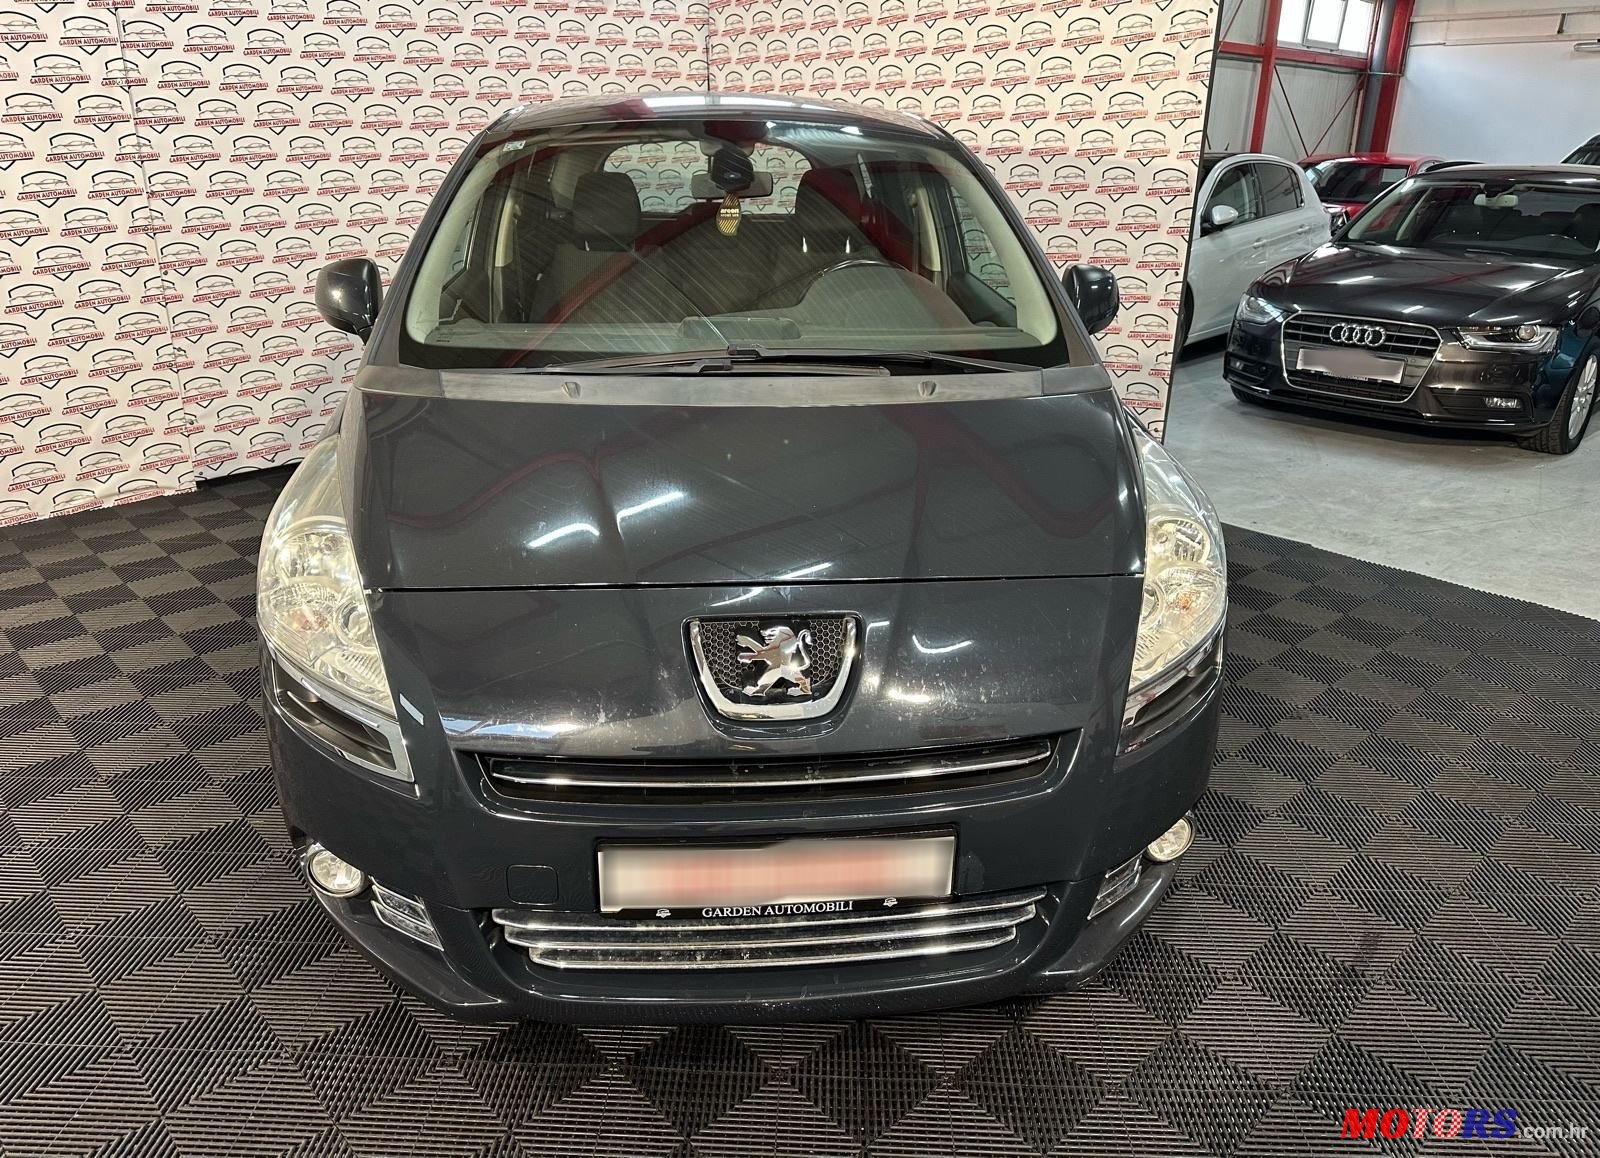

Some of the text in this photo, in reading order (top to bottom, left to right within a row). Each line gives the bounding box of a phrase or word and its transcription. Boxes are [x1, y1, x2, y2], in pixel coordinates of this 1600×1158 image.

[12, 33, 49, 41] AUTOMOBILI
[1182, 28, 1213, 39] AUTOMOBILI
[54, 74, 91, 82] AUTOMOBILI
[1150, 70, 1180, 80] AUTOMOBILI
[26, 112, 63, 121] AUTOMOBILI
[97, 114, 132, 122] AUTOMOBILI
[153, 116, 186, 124] AUTOMOBILI
[1173, 109, 1202, 119] AUTOMOBILI
[215, 117, 245, 125] AUTOMOBILI
[69, 151, 105, 160] AUTOMOBILI
[190, 152, 221, 161] AUTOMOBILI
[249, 152, 278, 161] AUTOMOBILI
[17, 188, 78, 201] GARDEN AUTOMOBILI
[88, 187, 144, 199] GARDEN AUTOMOBILI
[166, 188, 197, 197] AUTOMOBILI
[225, 187, 255, 196] AUTOMOBILI
[15, 226, 50, 238] AUTOMOBILI
[60, 224, 118, 237] GARDEN AUTOMOBILI
[201, 222, 232, 231] AUTOMOBILI
[101, 258, 156, 272] GARDEN AUTOMOBILI
[159, 257, 208, 271] ARDEN AUTOMOBILI
[236, 254, 264, 264] AUTOMOBILI
[32, 261, 92, 276] GARDEN AUTOMOBILI
[212, 289, 242, 299] AUTOMOBILI
[4, 299, 64, 314] GARDEN AUTOMOBILI
[74, 294, 131, 309] GARDEN AUTOMOBILI
[114, 326, 168, 341] GARDEN AUTOMOBILI
[171, 324, 218, 339] ARDEN AUTOMOBILI
[1, 338, 38, 349] AUTOMOBILI
[47, 331, 105, 347] GARDEN AUTOMOBILI
[88, 362, 143, 378] GARDEN AUTOMOBILI
[20, 369, 79, 385] GARDEN AUTOMOBILI
[148, 391, 180, 403] AUTOMOBILI
[182, 389, 228, 405] ARDEN AUTOMOBILI
[62, 398, 118, 415] GARDEN AUTOMOBILI
[0, 407, 52, 424] RDEN AUTOMOBILI
[123, 427, 155, 439] AUTOMOBILI
[35, 436, 92, 454] GARDEN AUTOMOBILI
[160, 454, 190, 466] AUTOMOBILI
[192, 459, 210, 468] ARDEN
[75, 463, 130, 481] GARDEN AUTOMOBILI
[8, 473, 66, 492] GARDEN AUTOMOBILI
[702, 901, 853, 917] GARDEN AUTOMOBILI
